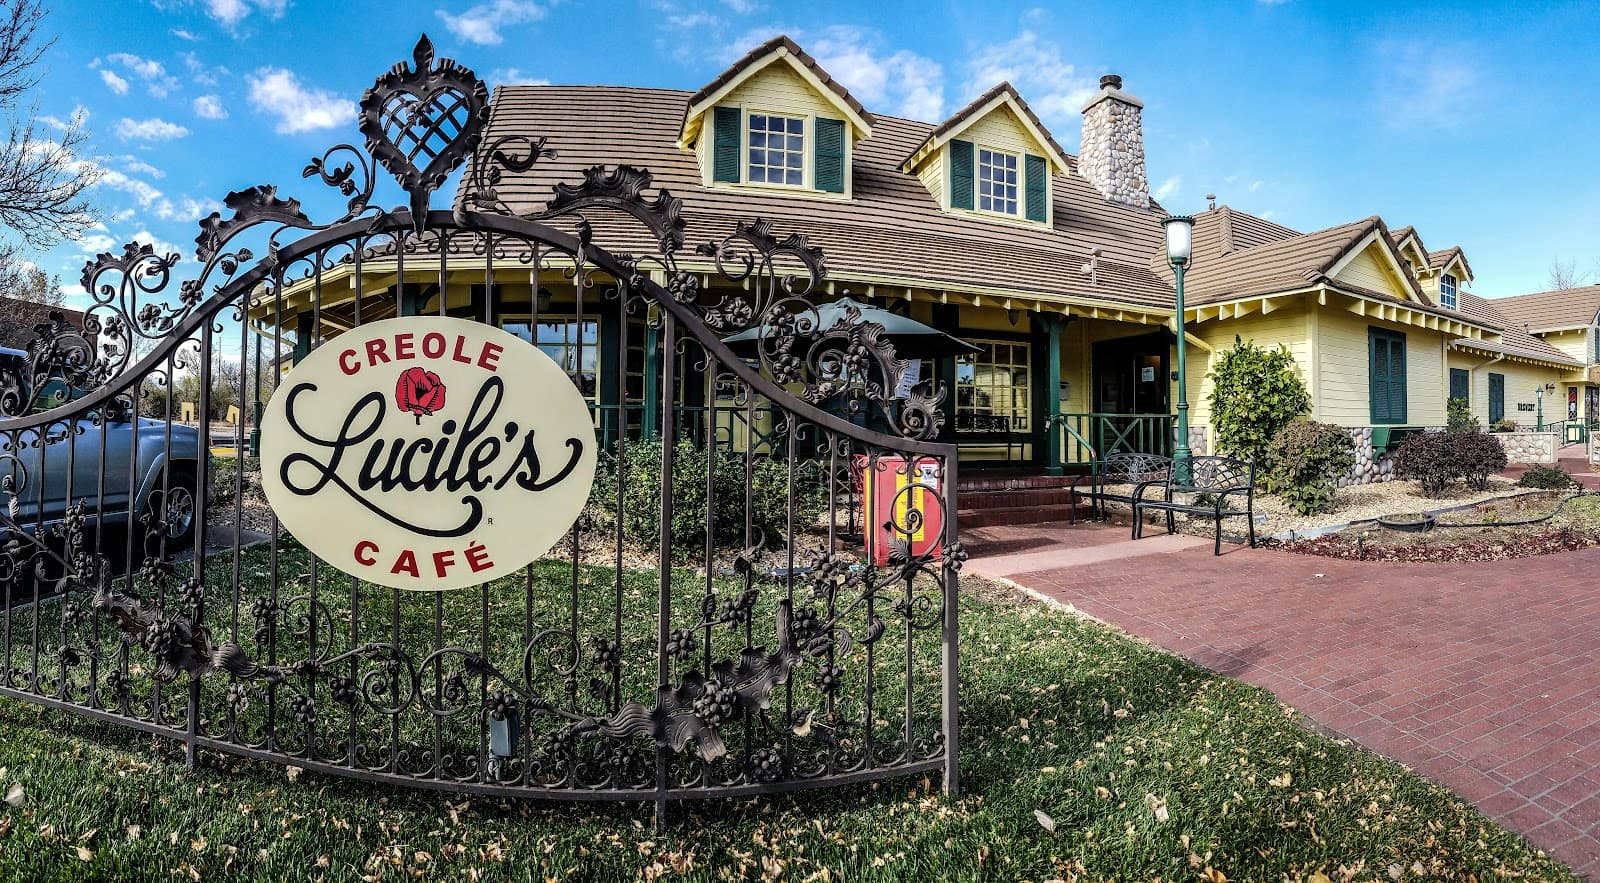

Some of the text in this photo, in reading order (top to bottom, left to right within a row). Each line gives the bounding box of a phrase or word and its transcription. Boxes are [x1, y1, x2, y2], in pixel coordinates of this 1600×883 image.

[339, 332, 504, 375] CREOLE
[280, 376, 583, 538] Lucile's
[354, 540, 494, 578] CAFÉ
